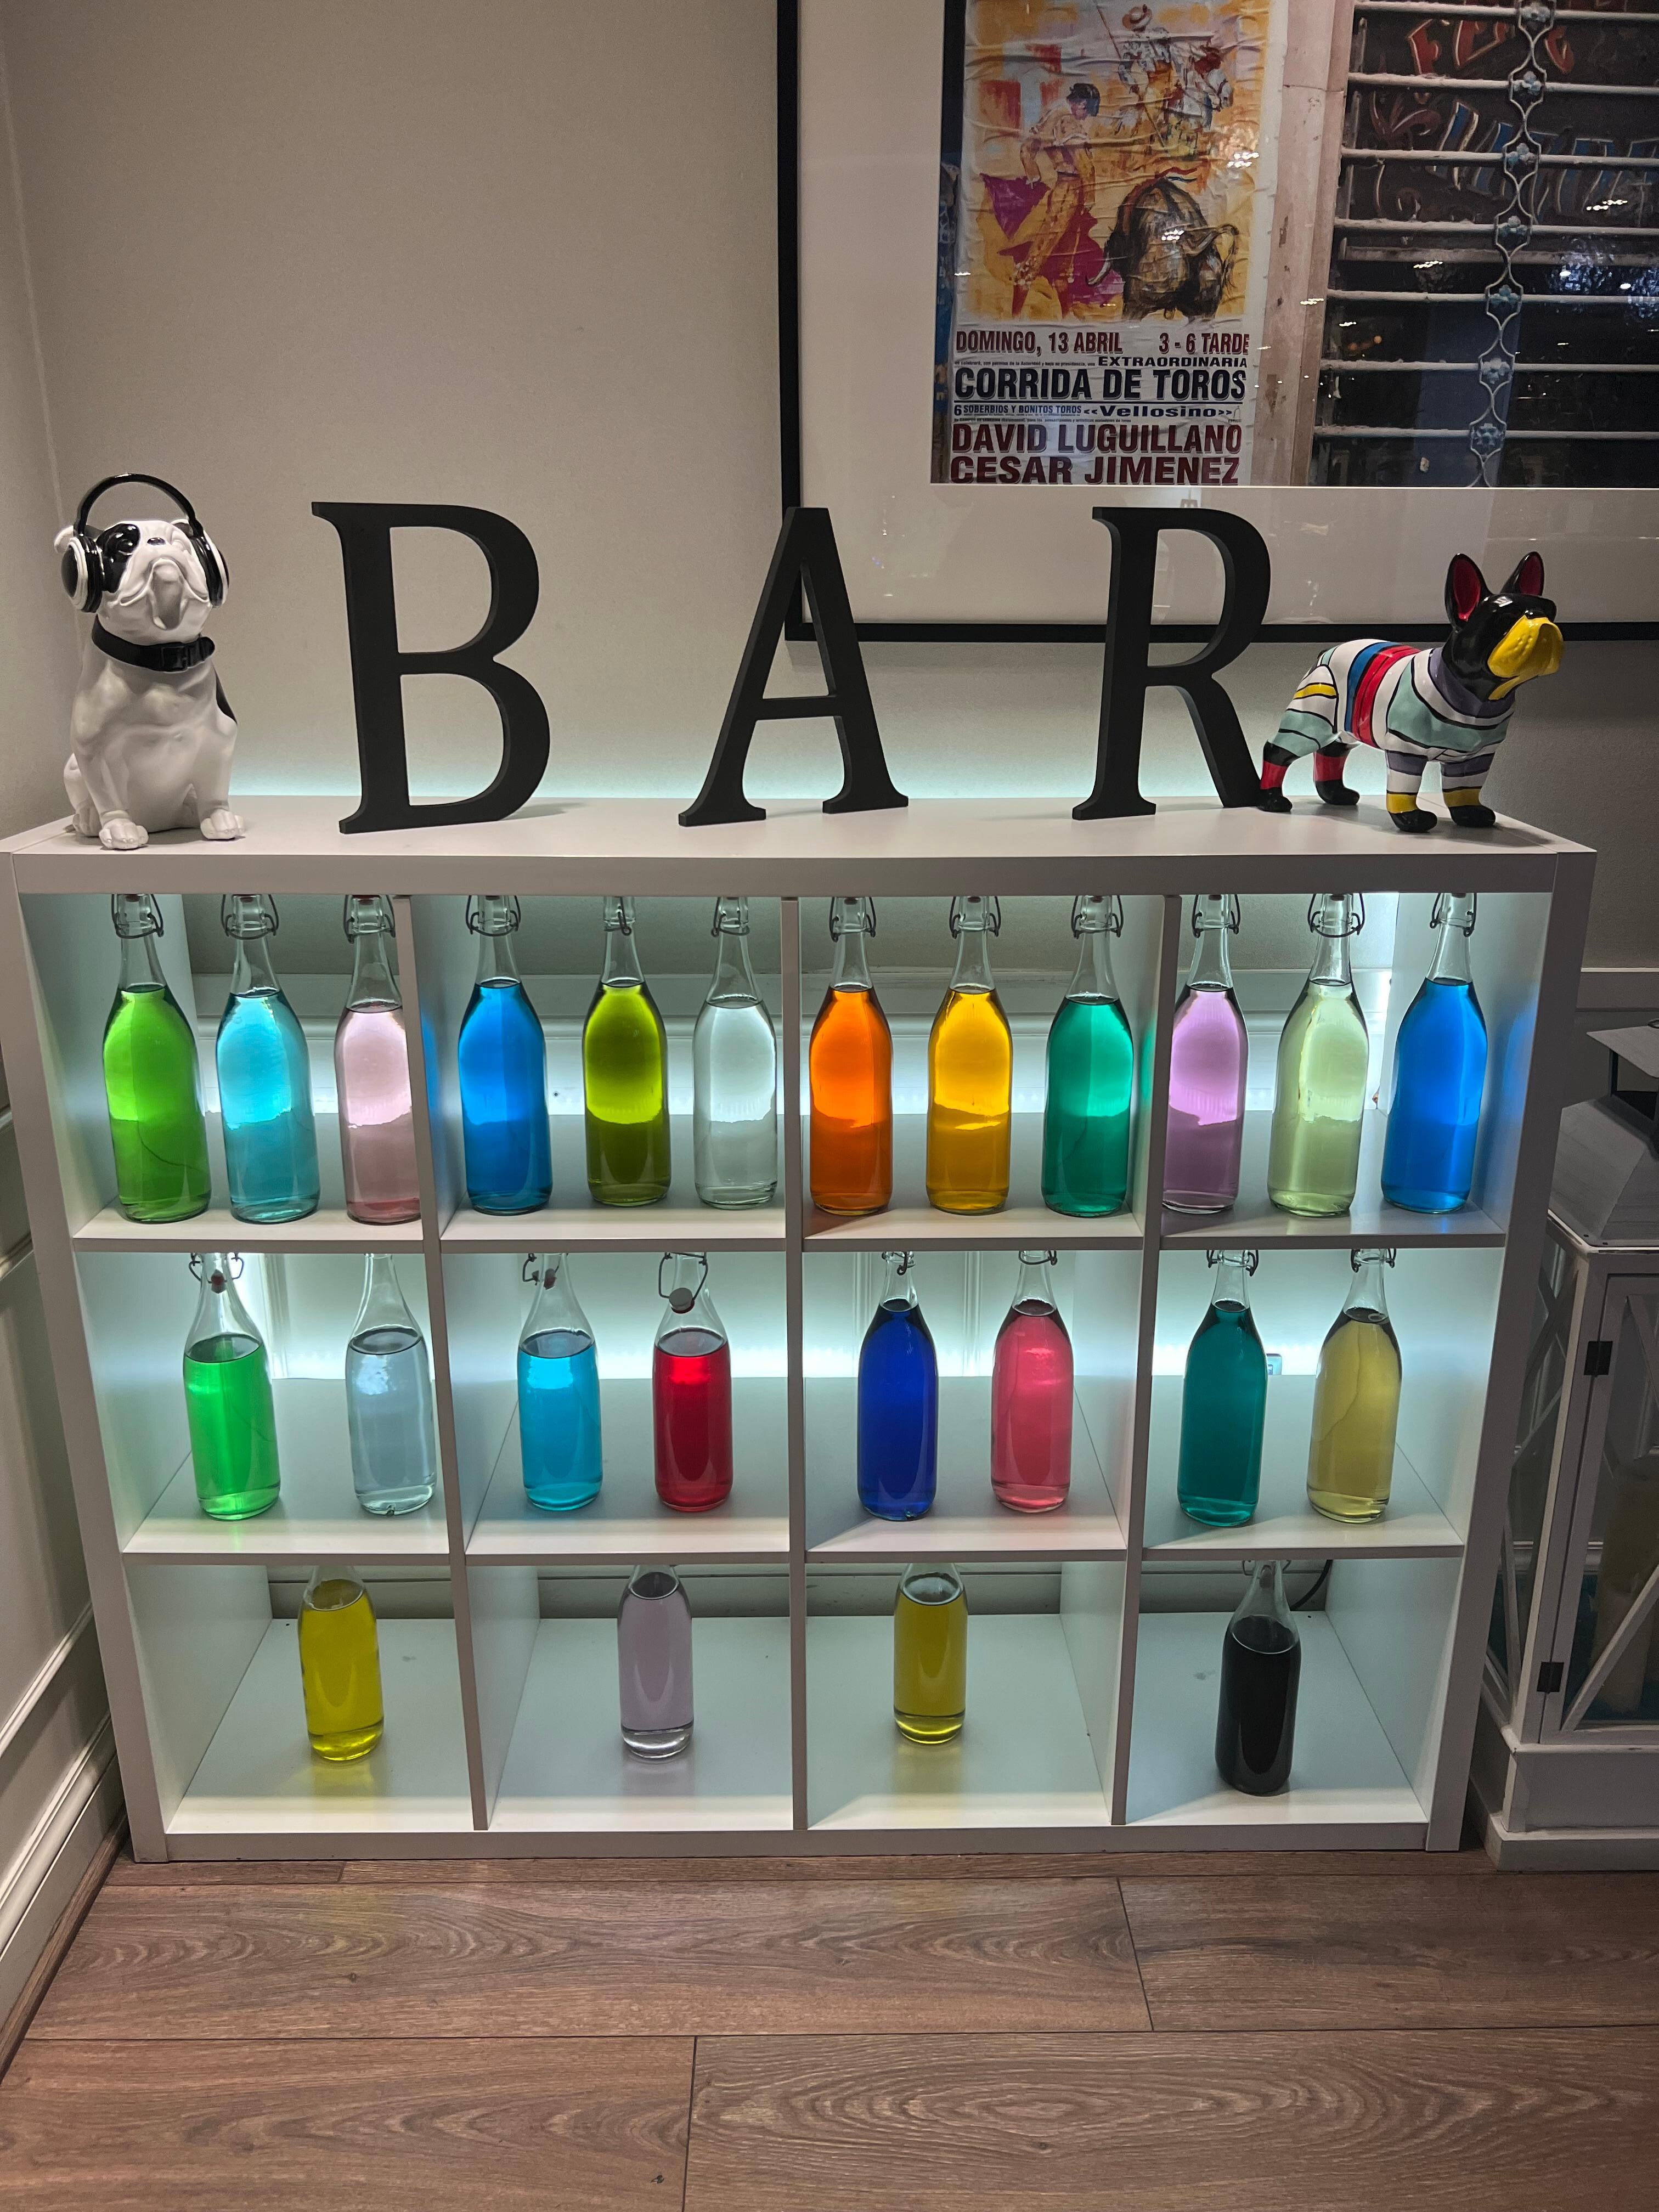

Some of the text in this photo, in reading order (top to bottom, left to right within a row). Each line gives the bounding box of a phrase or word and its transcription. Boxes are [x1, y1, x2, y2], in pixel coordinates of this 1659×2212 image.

[956, 331, 1041, 357] DOMINGO,
[1048, 332, 1068, 354] 13
[1074, 332, 1123, 354] ABRIL
[1159, 332, 1169, 354] 3
[1186, 333, 1196, 354] 6
[1201, 332, 1249, 355] TARDE
[1098, 357, 1247, 368] EXTRAORDINARIA
[955, 367, 1093, 400] CORRIDA
[1103, 369, 1142, 400] DE
[1153, 369, 1247, 400] TOROS
[954, 405, 962, 416] 6
[963, 404, 1009, 413] SOBERBIOS
[1011, 405, 1017, 413] Y
[1018, 405, 1053, 414] BONITOS
[1056, 405, 1082, 414] TOROS
[952, 424, 1242, 454] DAVID LUGUILLANO
[951, 455, 1240, 486] CESAR JIMENEZ
[312, 501, 1271, 834] BAR
